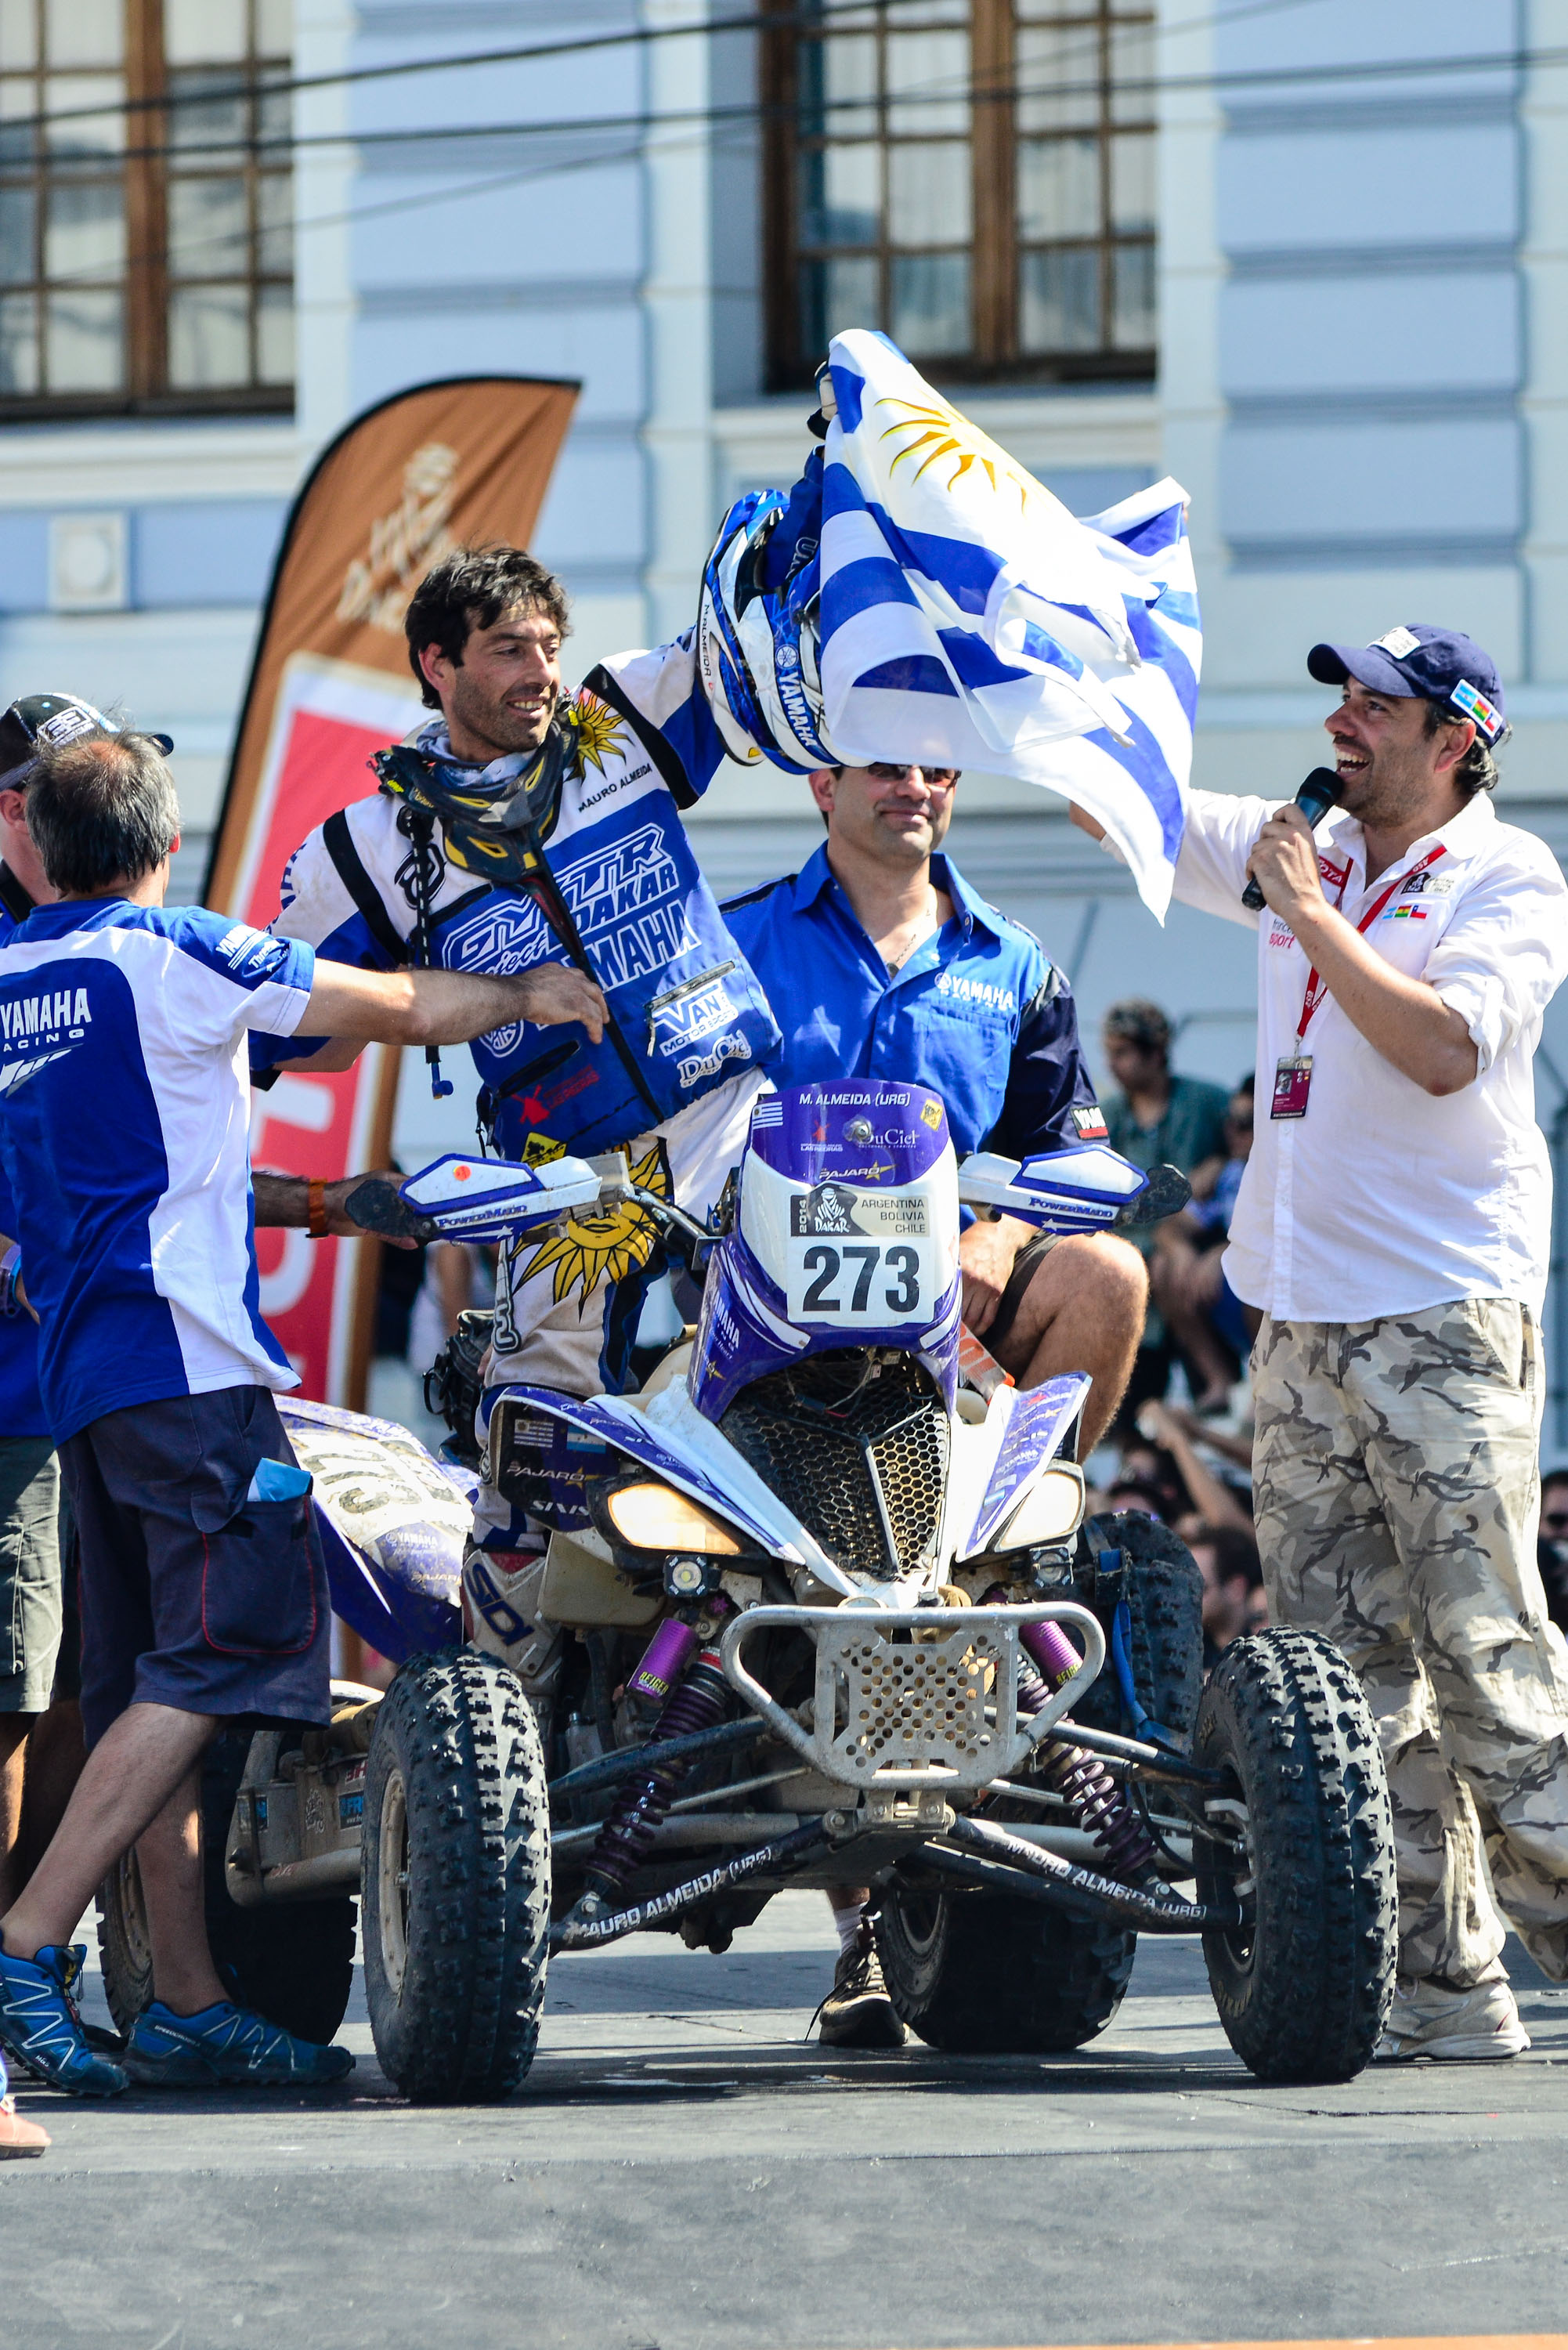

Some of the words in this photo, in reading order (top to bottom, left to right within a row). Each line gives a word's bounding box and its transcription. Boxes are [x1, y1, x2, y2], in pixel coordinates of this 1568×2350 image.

[779, 671, 818, 747] YAMAHA
[578, 783, 617, 812] MAURO
[620, 763, 653, 789] ALMEIDA
[1319, 862, 1344, 884] OTA
[576, 862, 680, 937] DAKAR
[583, 899, 703, 994] MAHA
[652, 983, 723, 1032] VAN
[952, 975, 1013, 1009] YAMAHA
[0, 988, 92, 1039] YAMAHA
[3, 1028, 85, 1052] ACING
[663, 1024, 706, 1053] MOTOR
[799, 1093, 813, 1105] M.
[815, 1094, 872, 1105] ALMEIDA
[875, 1092, 911, 1107] (URG)
[799, 1199, 807, 1234] 2014
[862, 1199, 925, 1209] ARGENTINA
[880, 1211, 925, 1220] BOLIVIA
[815, 1216, 850, 1233] DAKAR
[895, 1224, 926, 1234] CHILE
[802, 1246, 920, 1313] 273
[398, 1532, 439, 1547] YAMAHA
[638, 1671, 670, 1694] REIGER
[646, 1867, 721, 1918] ALMEIDA
[1072, 1868, 1156, 1908] ALMEIDA
